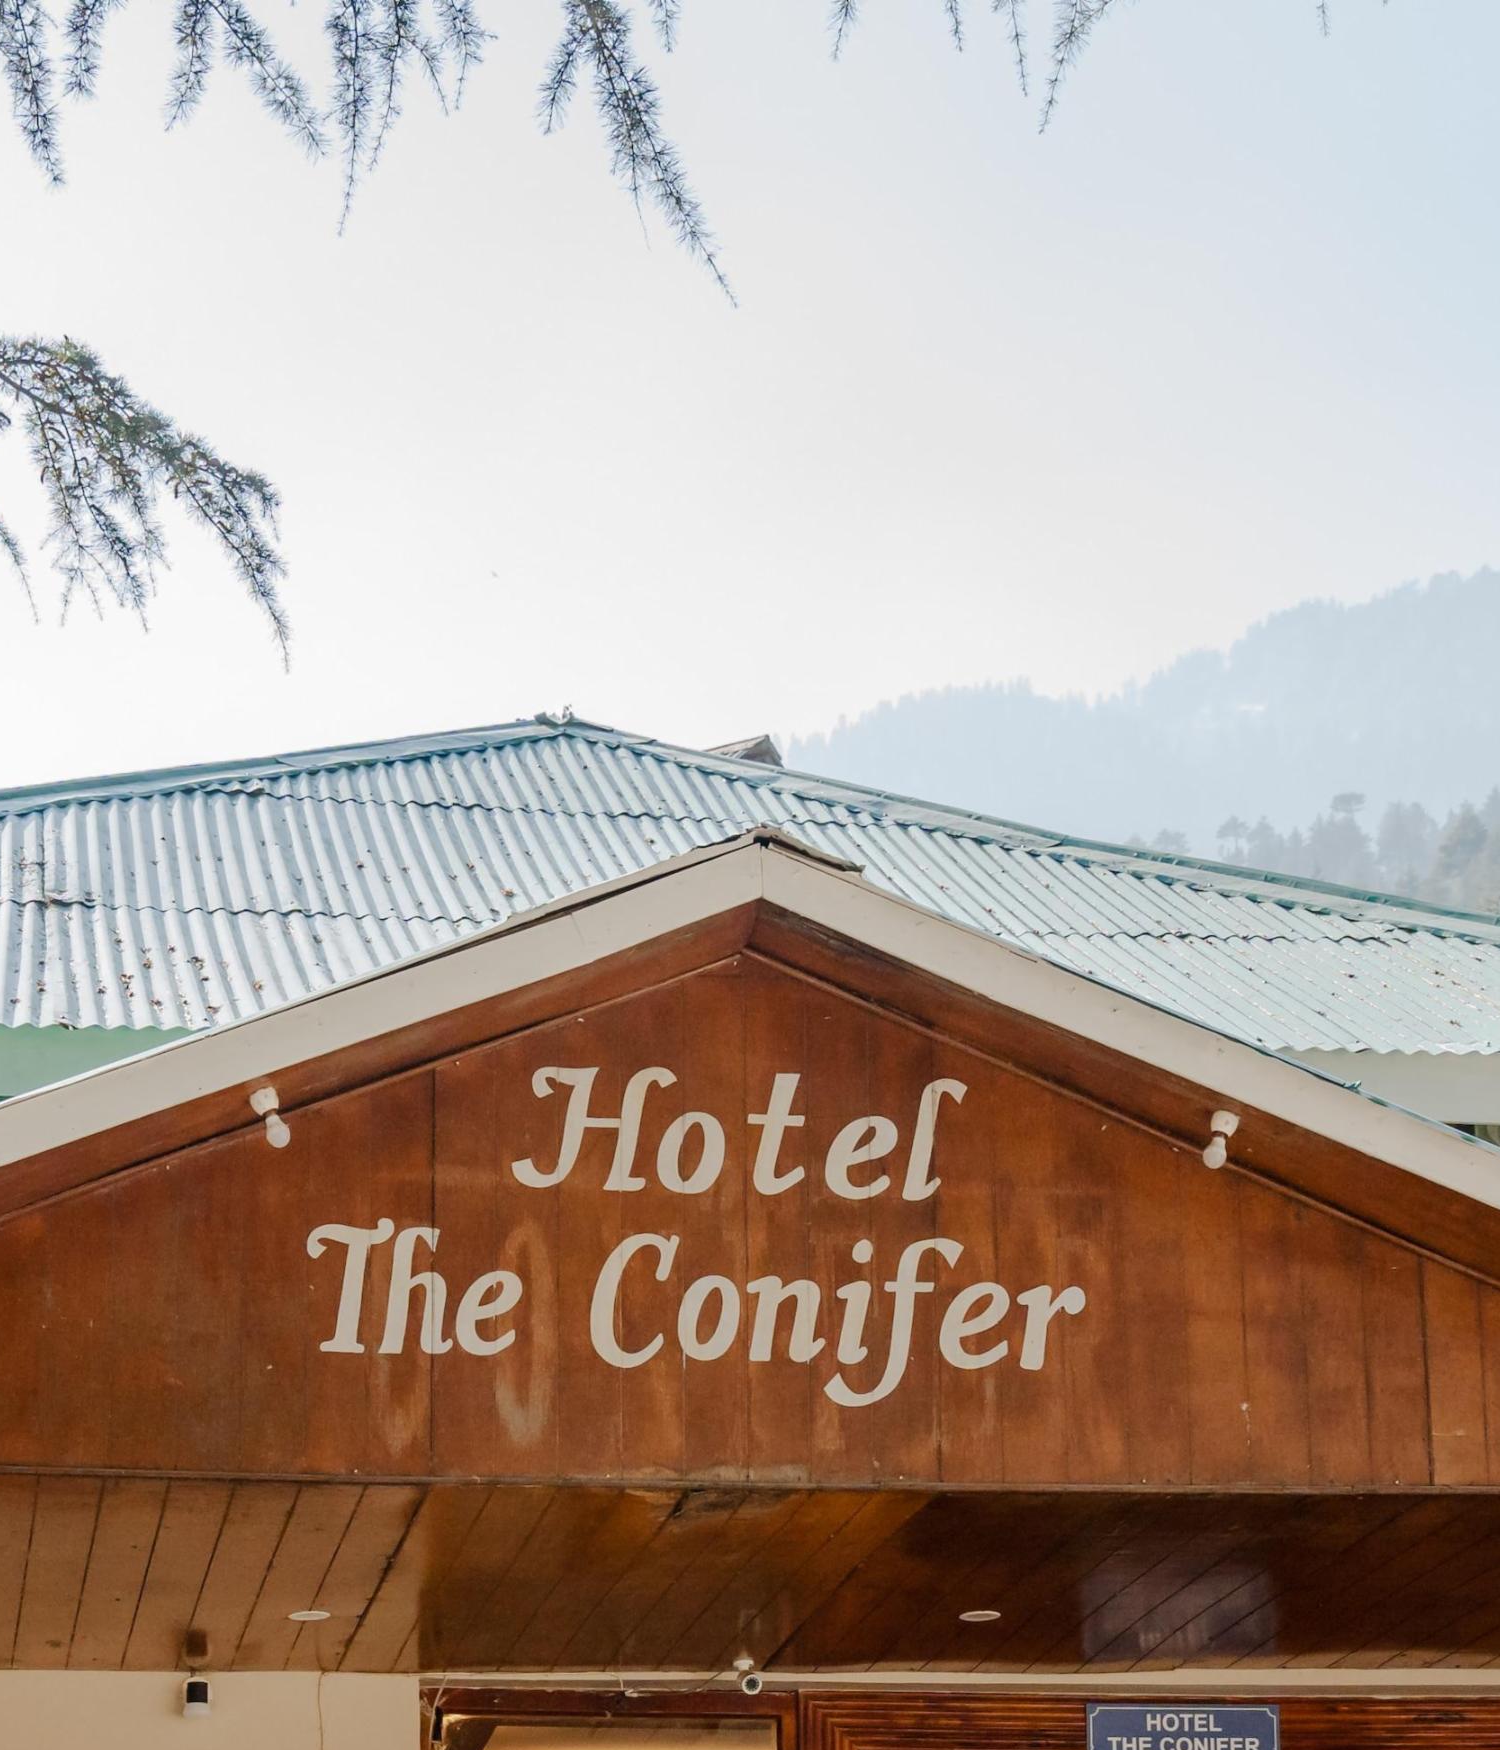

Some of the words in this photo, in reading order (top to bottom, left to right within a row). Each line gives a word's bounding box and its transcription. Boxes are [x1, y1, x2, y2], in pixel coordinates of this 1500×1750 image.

[512, 1066, 968, 1201] Hotel
[306, 1217, 523, 1356] The
[590, 1233, 1086, 1407] Conifer
[1146, 1713, 1222, 1732] HOTEL
